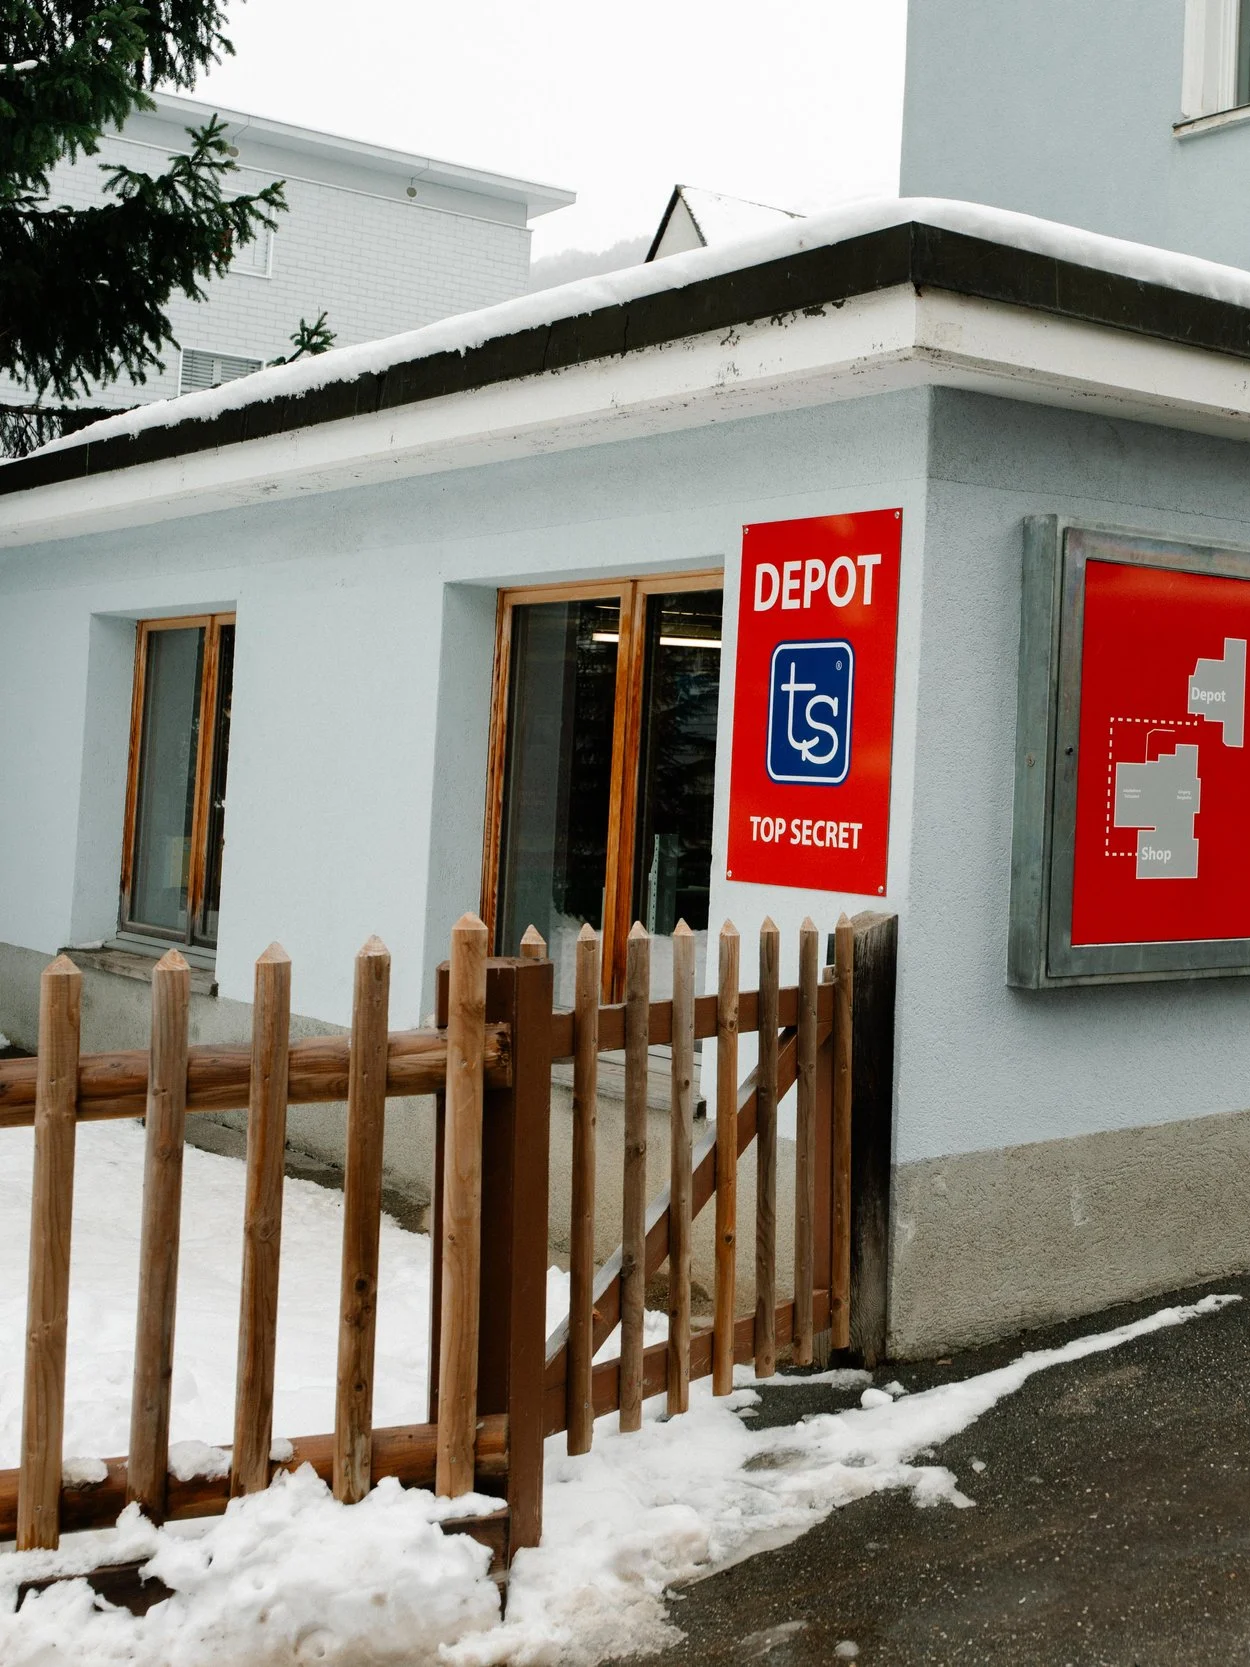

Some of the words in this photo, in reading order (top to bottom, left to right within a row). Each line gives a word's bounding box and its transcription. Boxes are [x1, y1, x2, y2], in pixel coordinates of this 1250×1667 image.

[754, 554, 881, 611] DEPOT
[1192, 687, 1226, 704] Depot
[750, 816, 786, 842] TOP
[790, 819, 862, 849] SECRET
[1142, 846, 1171, 864] Shop
